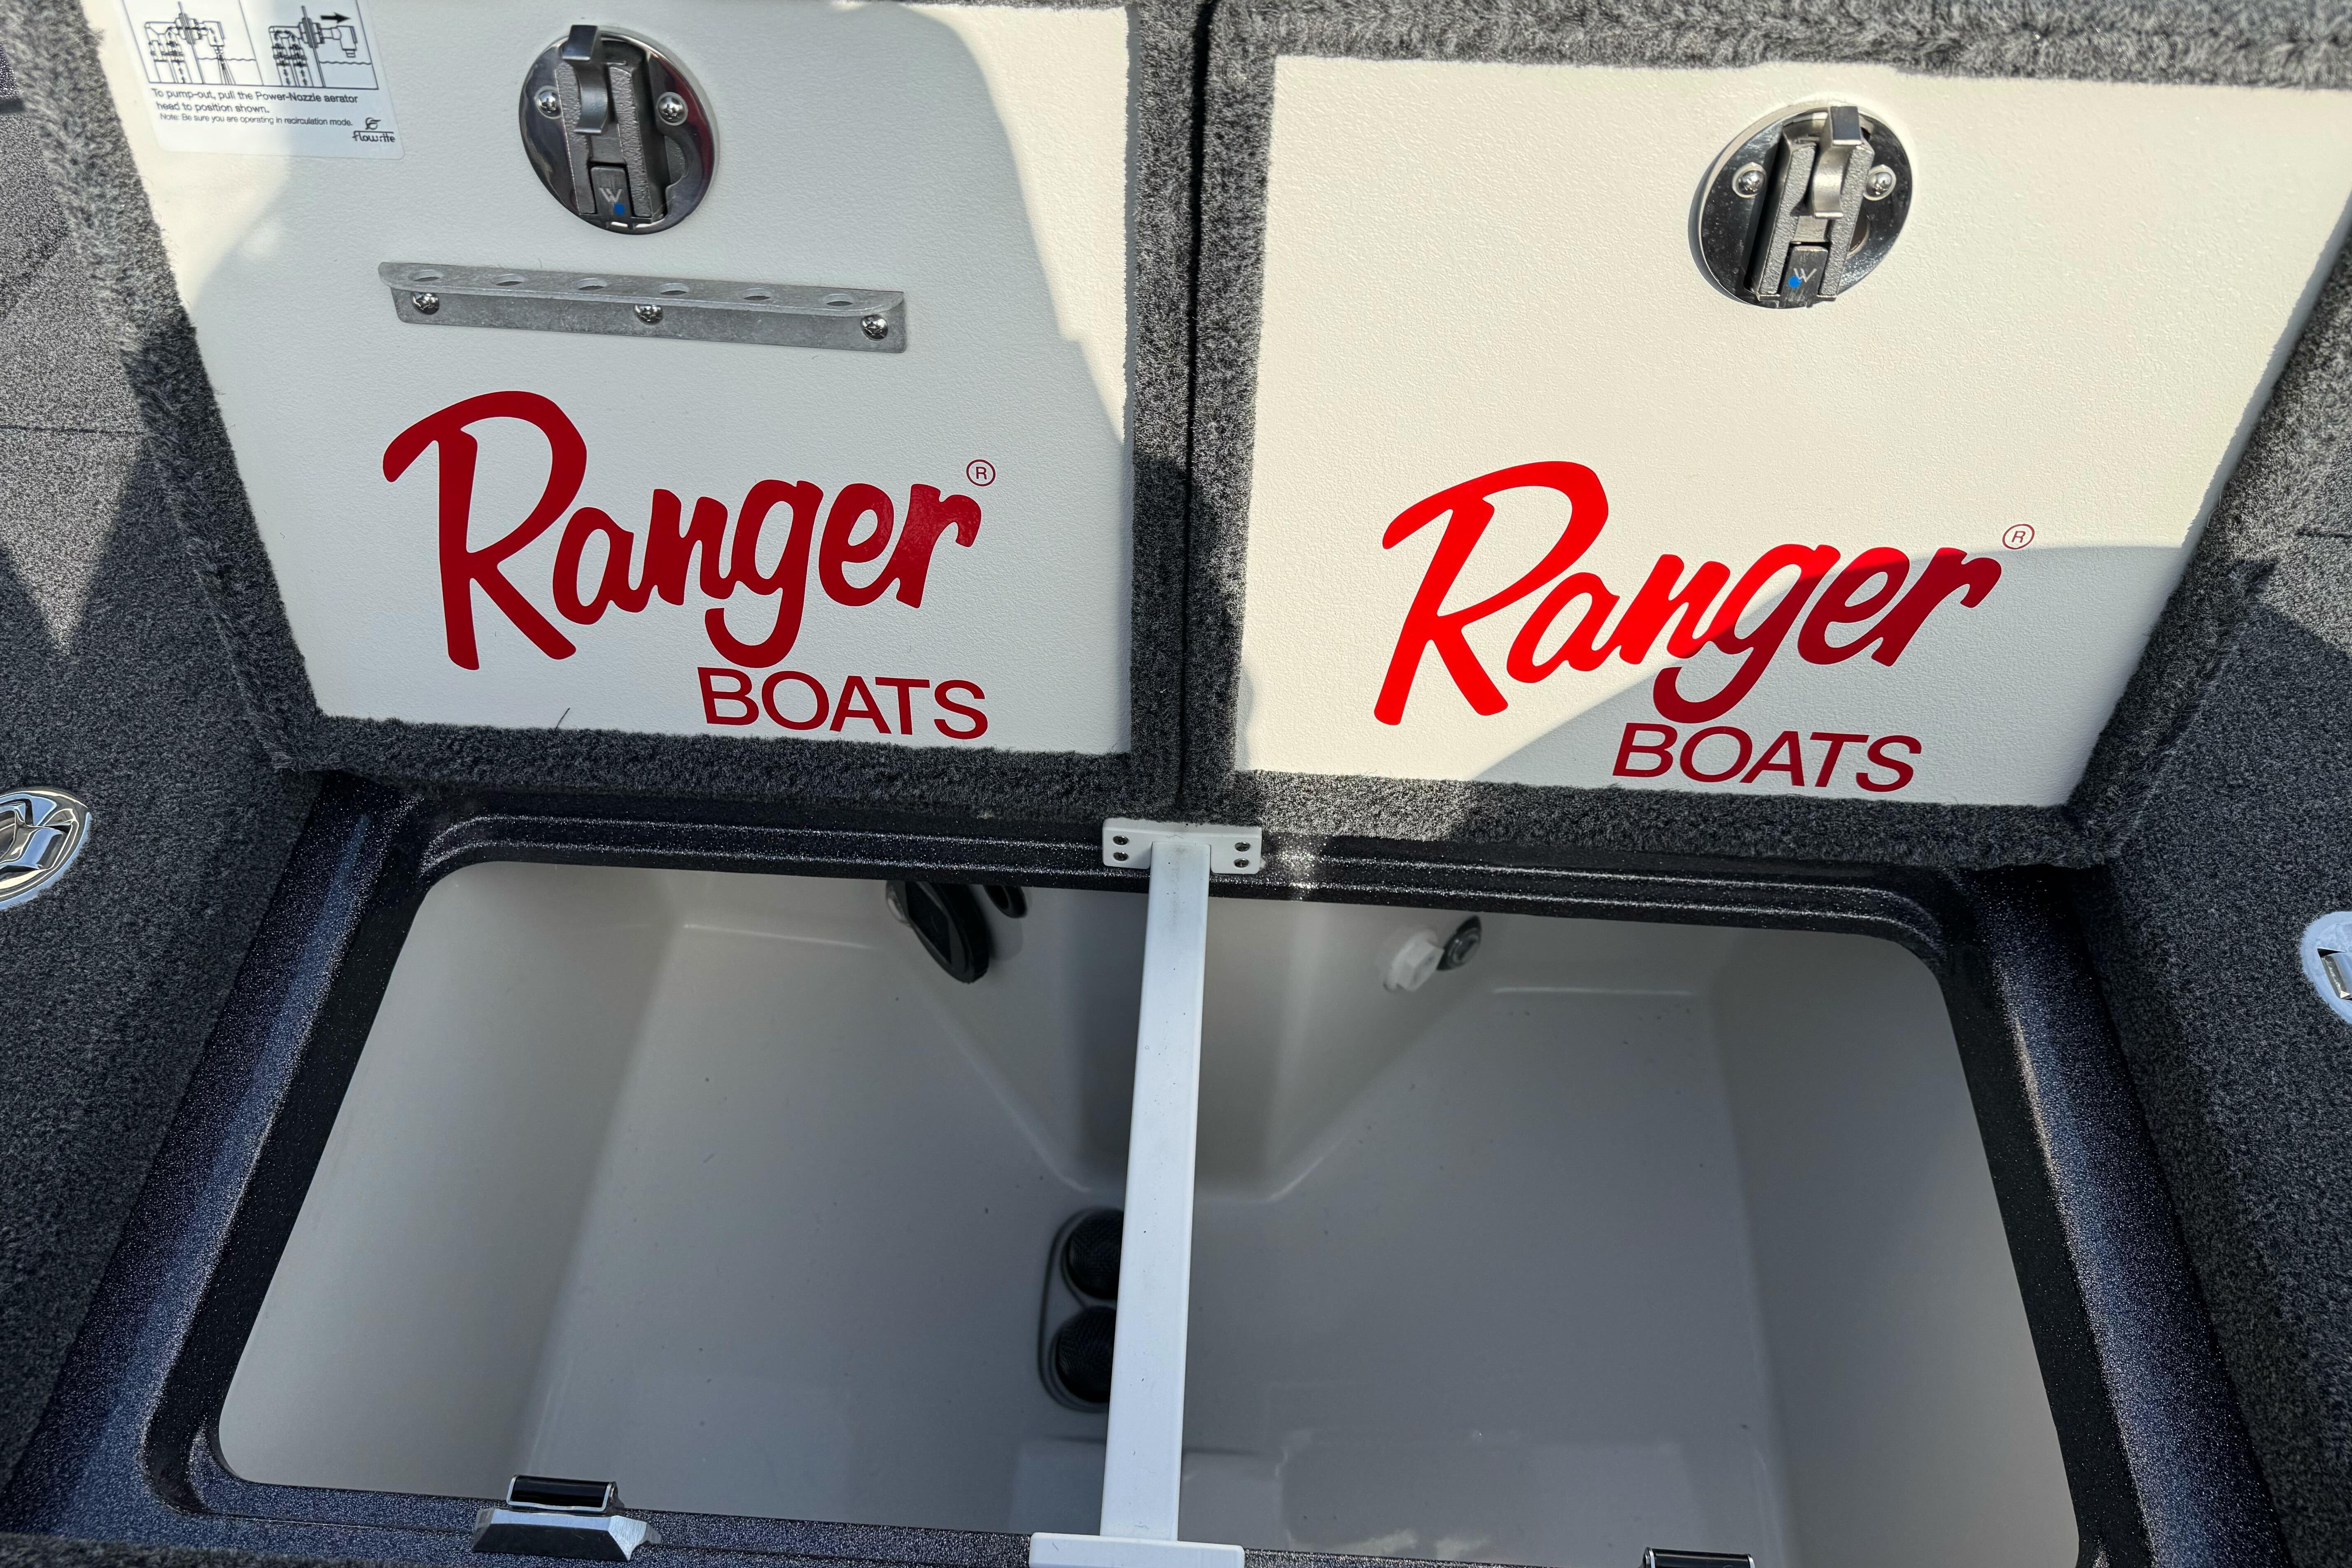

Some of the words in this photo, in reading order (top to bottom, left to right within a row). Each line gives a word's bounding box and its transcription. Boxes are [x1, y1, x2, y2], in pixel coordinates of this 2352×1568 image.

[152, 88, 163, 97] To
[166, 90, 216, 100] pump-out,
[218, 91, 236, 100] pull
[255, 91, 321, 102] Power-Nozzle
[324, 94, 358, 103] aerator
[156, 102, 180, 110] head
[195, 103, 233, 114] position
[235, 104, 270, 113] shown.
[240, 117, 274, 125] operating
[383, 391, 981, 670] Ranger
[1374, 461, 2001, 726] Ranger
[698, 667, 987, 739] BOATS
[1614, 723, 1921, 792] BOATS
